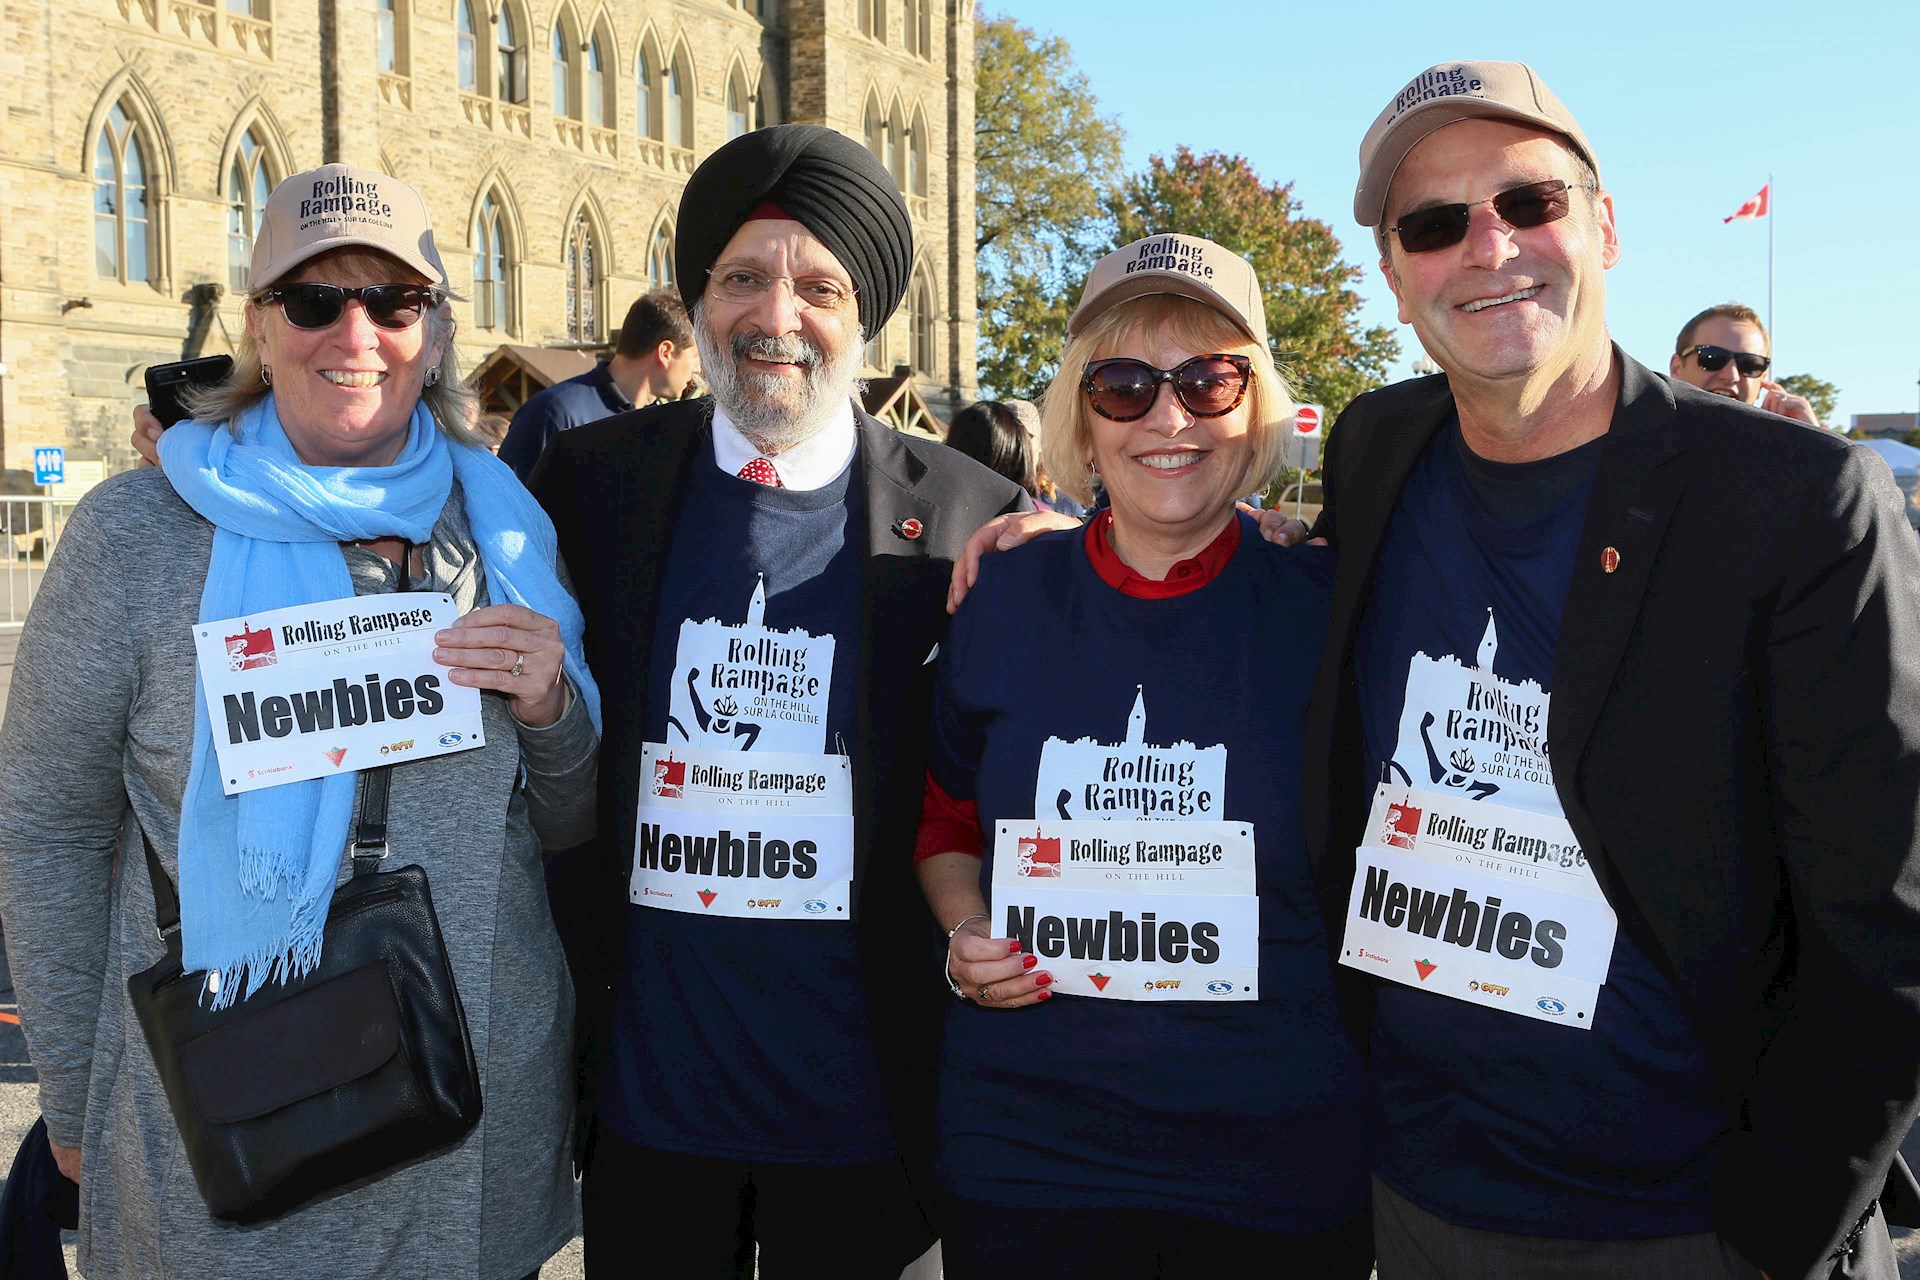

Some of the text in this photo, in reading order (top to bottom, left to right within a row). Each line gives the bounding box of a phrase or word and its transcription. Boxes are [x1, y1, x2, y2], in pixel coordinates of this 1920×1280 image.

[1397, 68, 1464, 112] Rolling
[313, 176, 377, 199] Rolling
[300, 196, 391, 218] Rampage
[1139, 237, 1204, 261] Rolling
[1126, 255, 1213, 279] Rampage
[282, 608, 433, 646] Rolling Rampage
[324, 638, 402, 656] ON THE HILL
[728, 638, 808, 673] Rolling
[711, 663, 819, 698] Rampage
[223, 673, 444, 745] Newbies
[744, 706, 820, 724] SUR LA COLLINE
[754, 696, 812, 714] ON THE HILL
[1467, 681, 1541, 733] Rolling
[1103, 755, 1195, 787] Rolling
[1481, 762, 1504, 776] SUR
[1507, 767, 1520, 780] LA
[1494, 752, 1552, 772] ON THE HIL
[691, 764, 826, 793] Rolling Rampage
[740, 798, 760, 806] THE
[1085, 784, 1211, 815] Rampage
[640, 822, 818, 880] Newbies
[1070, 839, 1222, 866] Rolling Rampage
[1427, 812, 1587, 868] Rolling Rampage
[1456, 854, 1540, 879] ON THE HILL
[1359, 865, 1567, 968] Newbies
[1006, 905, 1220, 965] Newbies
